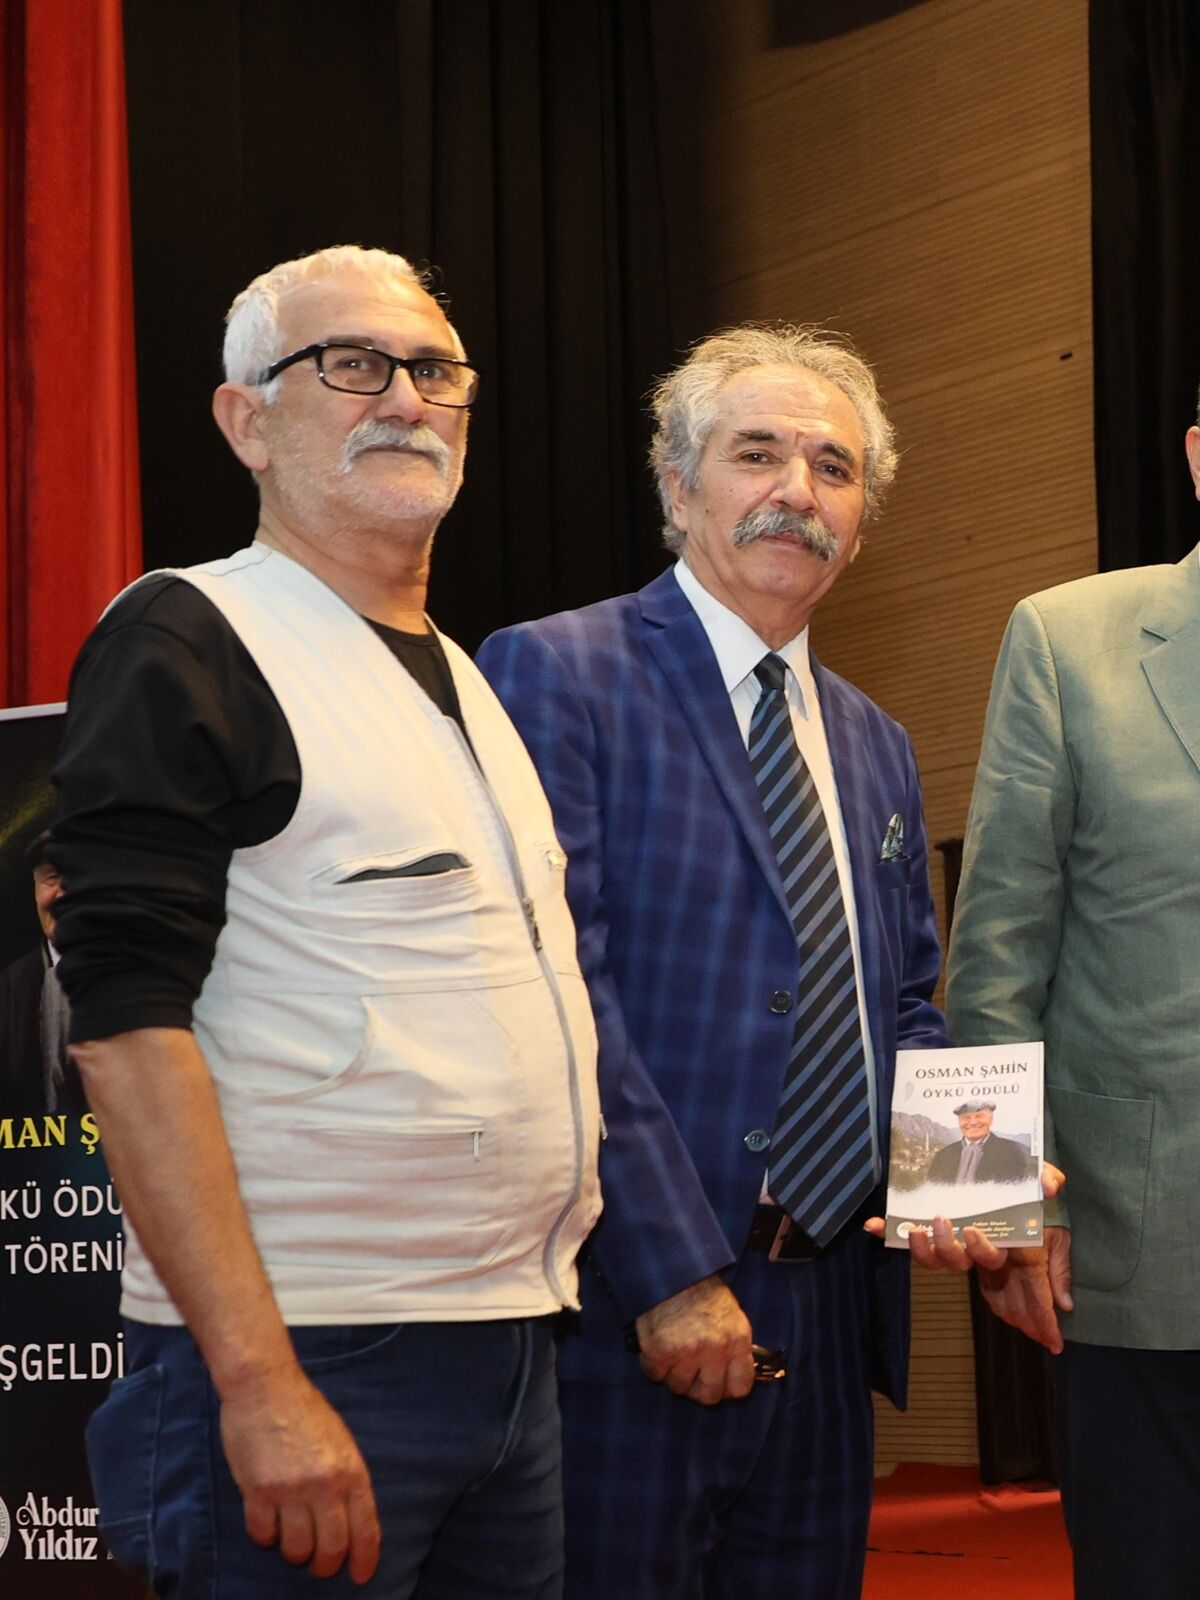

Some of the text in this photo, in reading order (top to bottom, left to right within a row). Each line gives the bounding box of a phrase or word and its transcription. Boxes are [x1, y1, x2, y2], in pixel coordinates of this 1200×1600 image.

[915, 1060, 1028, 1080] OSMAN ŞAHİN
[922, 1083, 1021, 1099] ÖYKÜ ÖDÜLÜ
[0, 1181, 41, 1220] KÜ
[4, 1232, 123, 1275] TÖRENİ
[16, 1491, 100, 1527] Abdur
[18, 1528, 98, 1560] Yıldız
